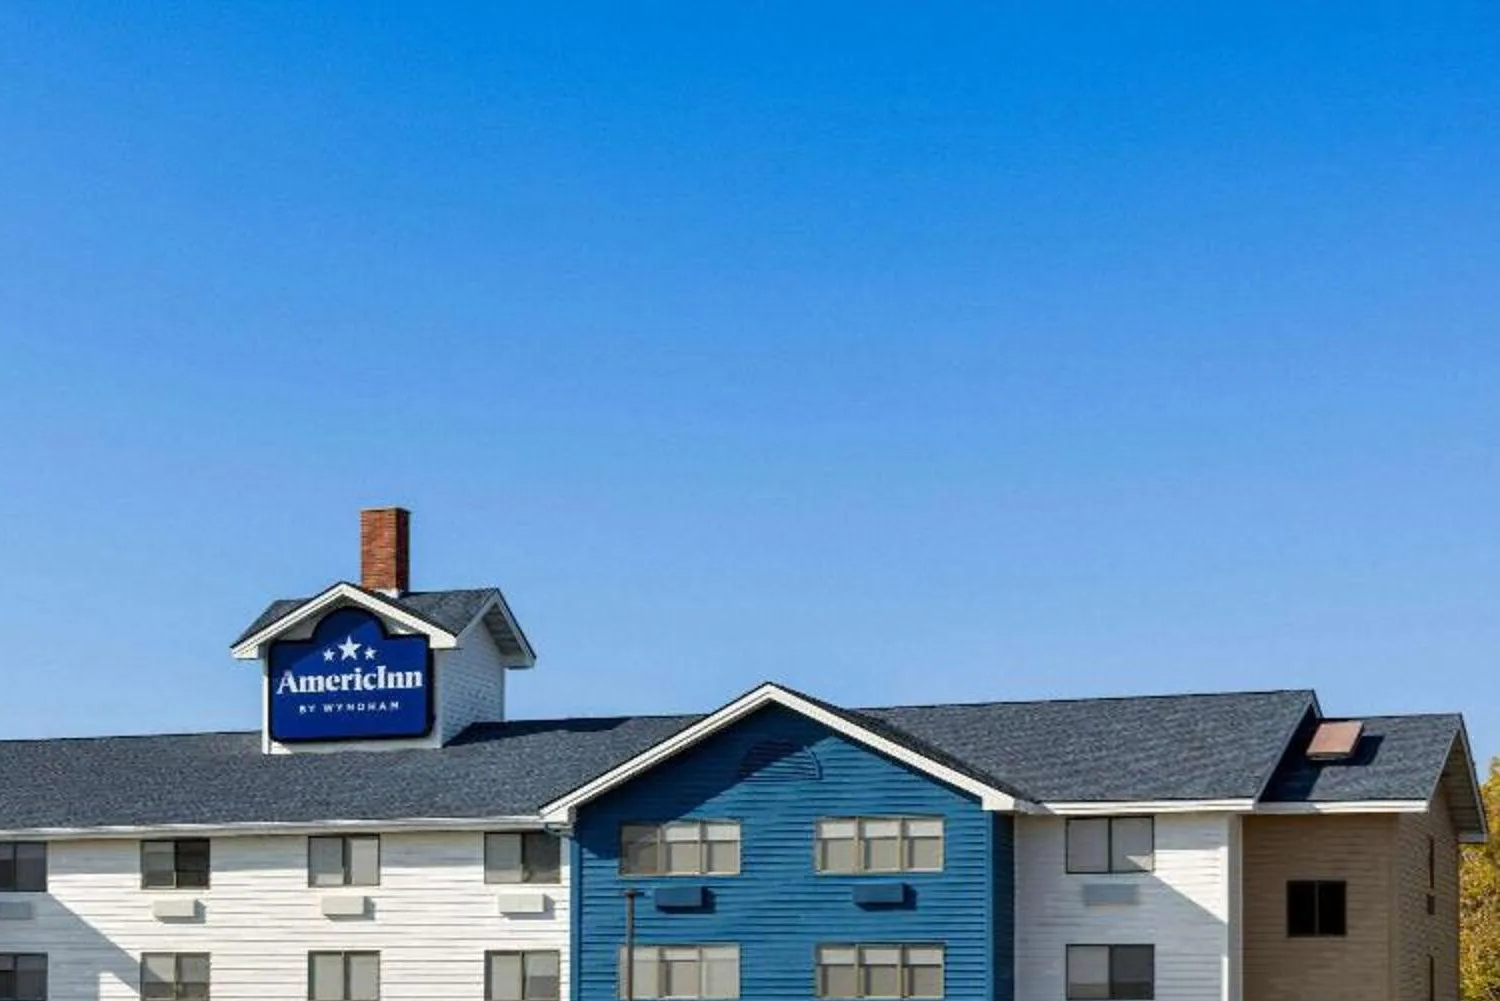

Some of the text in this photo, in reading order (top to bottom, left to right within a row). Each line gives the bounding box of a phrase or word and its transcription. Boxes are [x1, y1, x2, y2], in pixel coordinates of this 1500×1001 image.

[276, 665, 423, 695] AmericInn
[299, 701, 400, 714] BY WYNDHAM
